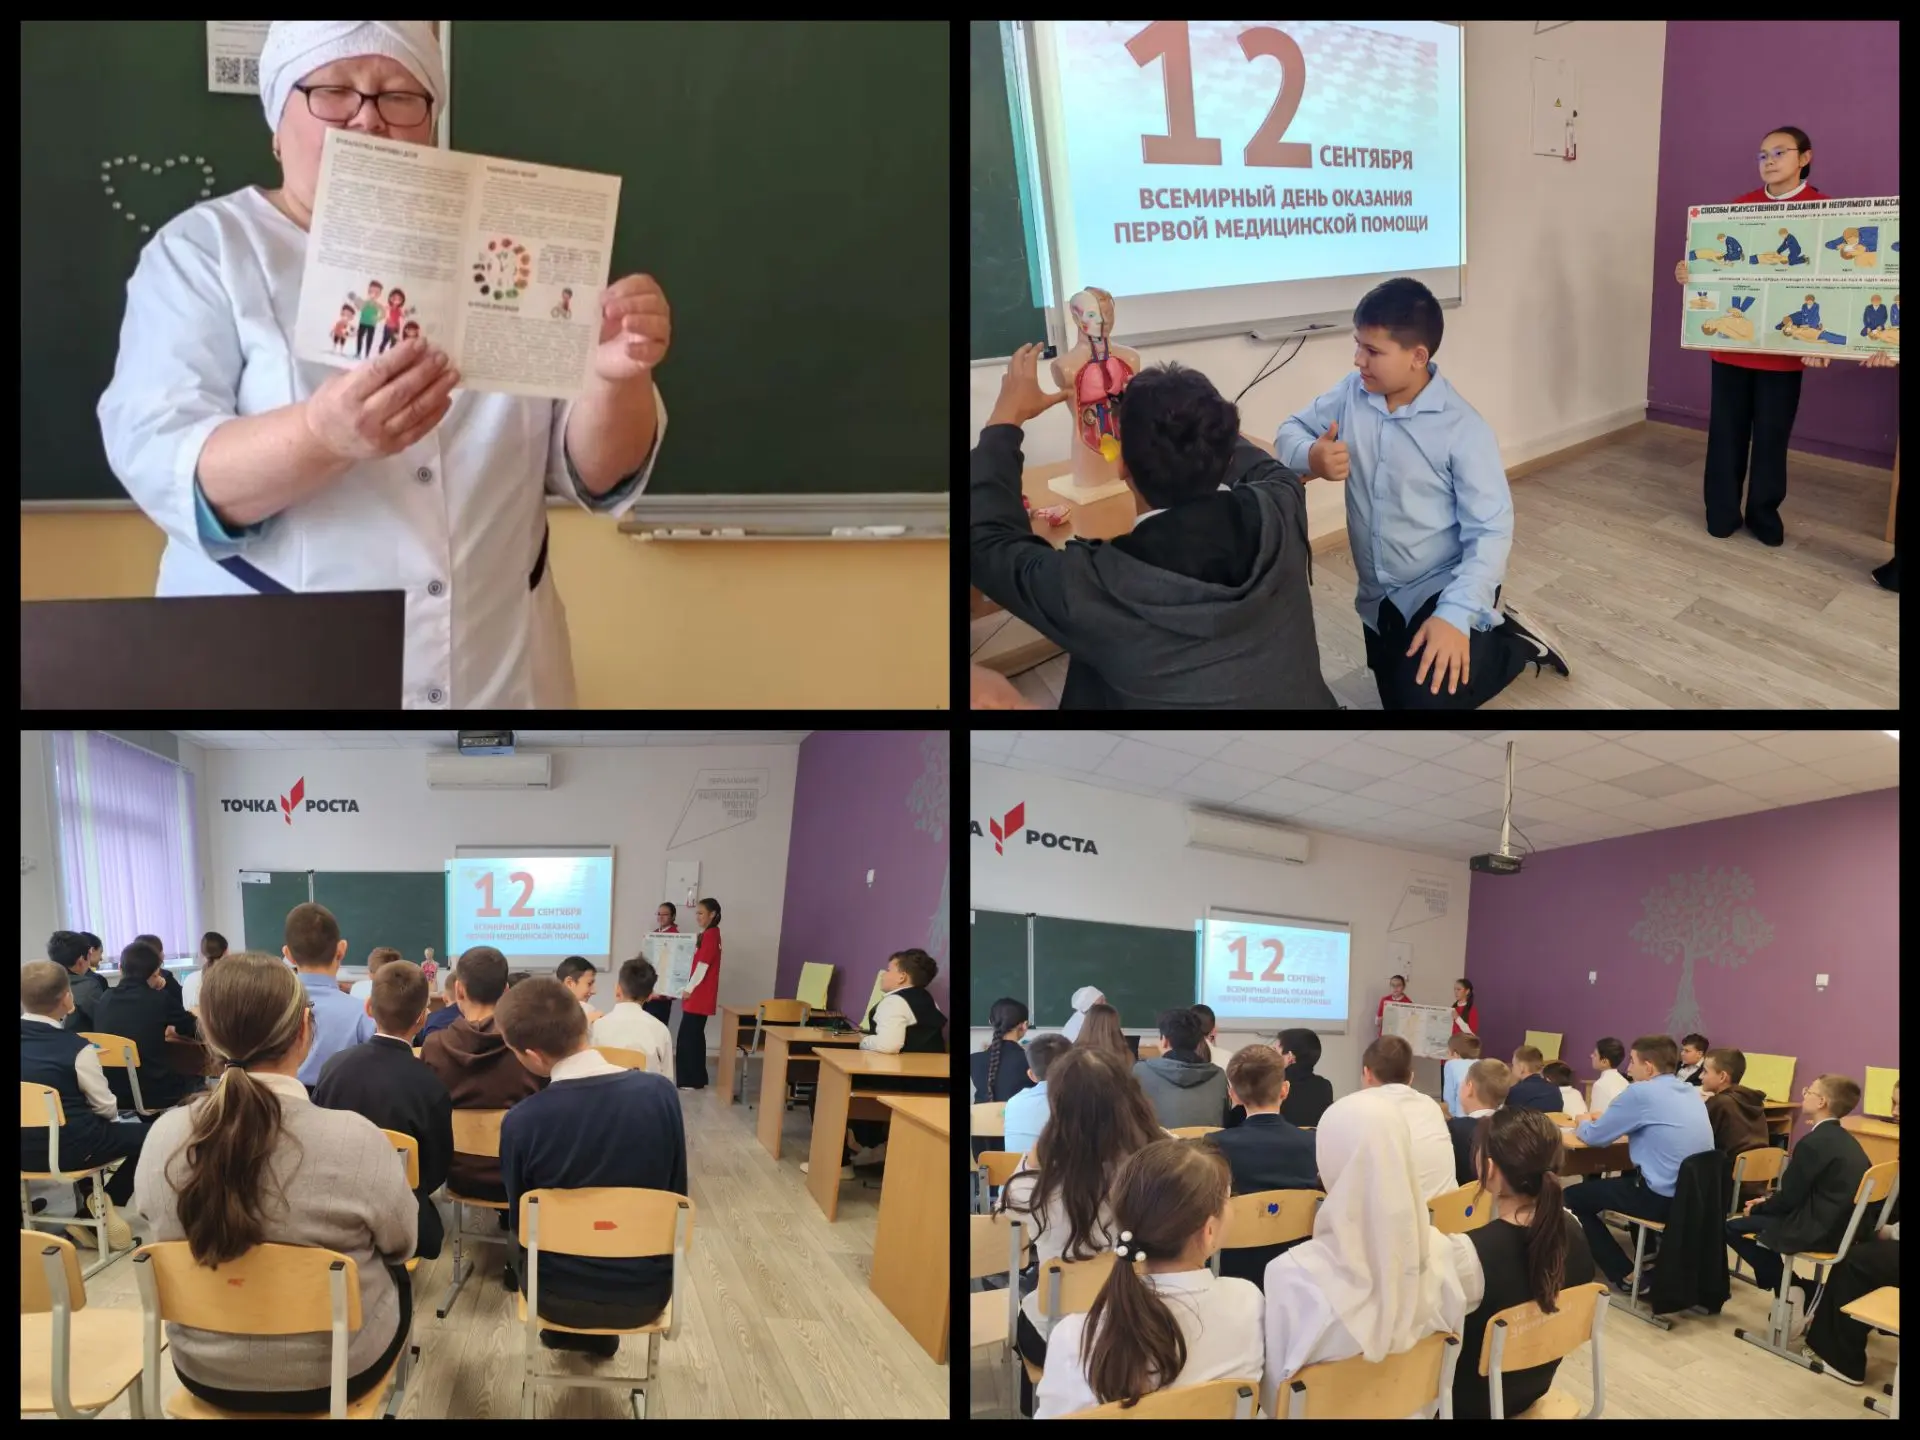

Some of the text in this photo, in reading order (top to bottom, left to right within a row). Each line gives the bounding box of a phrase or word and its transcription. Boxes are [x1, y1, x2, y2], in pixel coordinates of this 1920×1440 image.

[1124, 21, 1414, 170] 12 СЕНТЯБРЯ
[1139, 185, 1413, 210] ВСЕМИРНЫЙ ДЕНЬ ОКАЗАНИЯ
[1700, 206, 1730, 215] СПОСОБЫ
[1829, 200, 1872, 209] НЕПРЯМОГО
[1114, 213, 1429, 244] ПЕРВОЙ МЕДИЦИНСКОЙ ПОМОЩИ
[221, 799, 360, 812] ТОЧКА РОСТА
[1026, 829, 1099, 855] РОСТА
[474, 872, 535, 917] 12
[1228, 936, 1285, 982] 12
